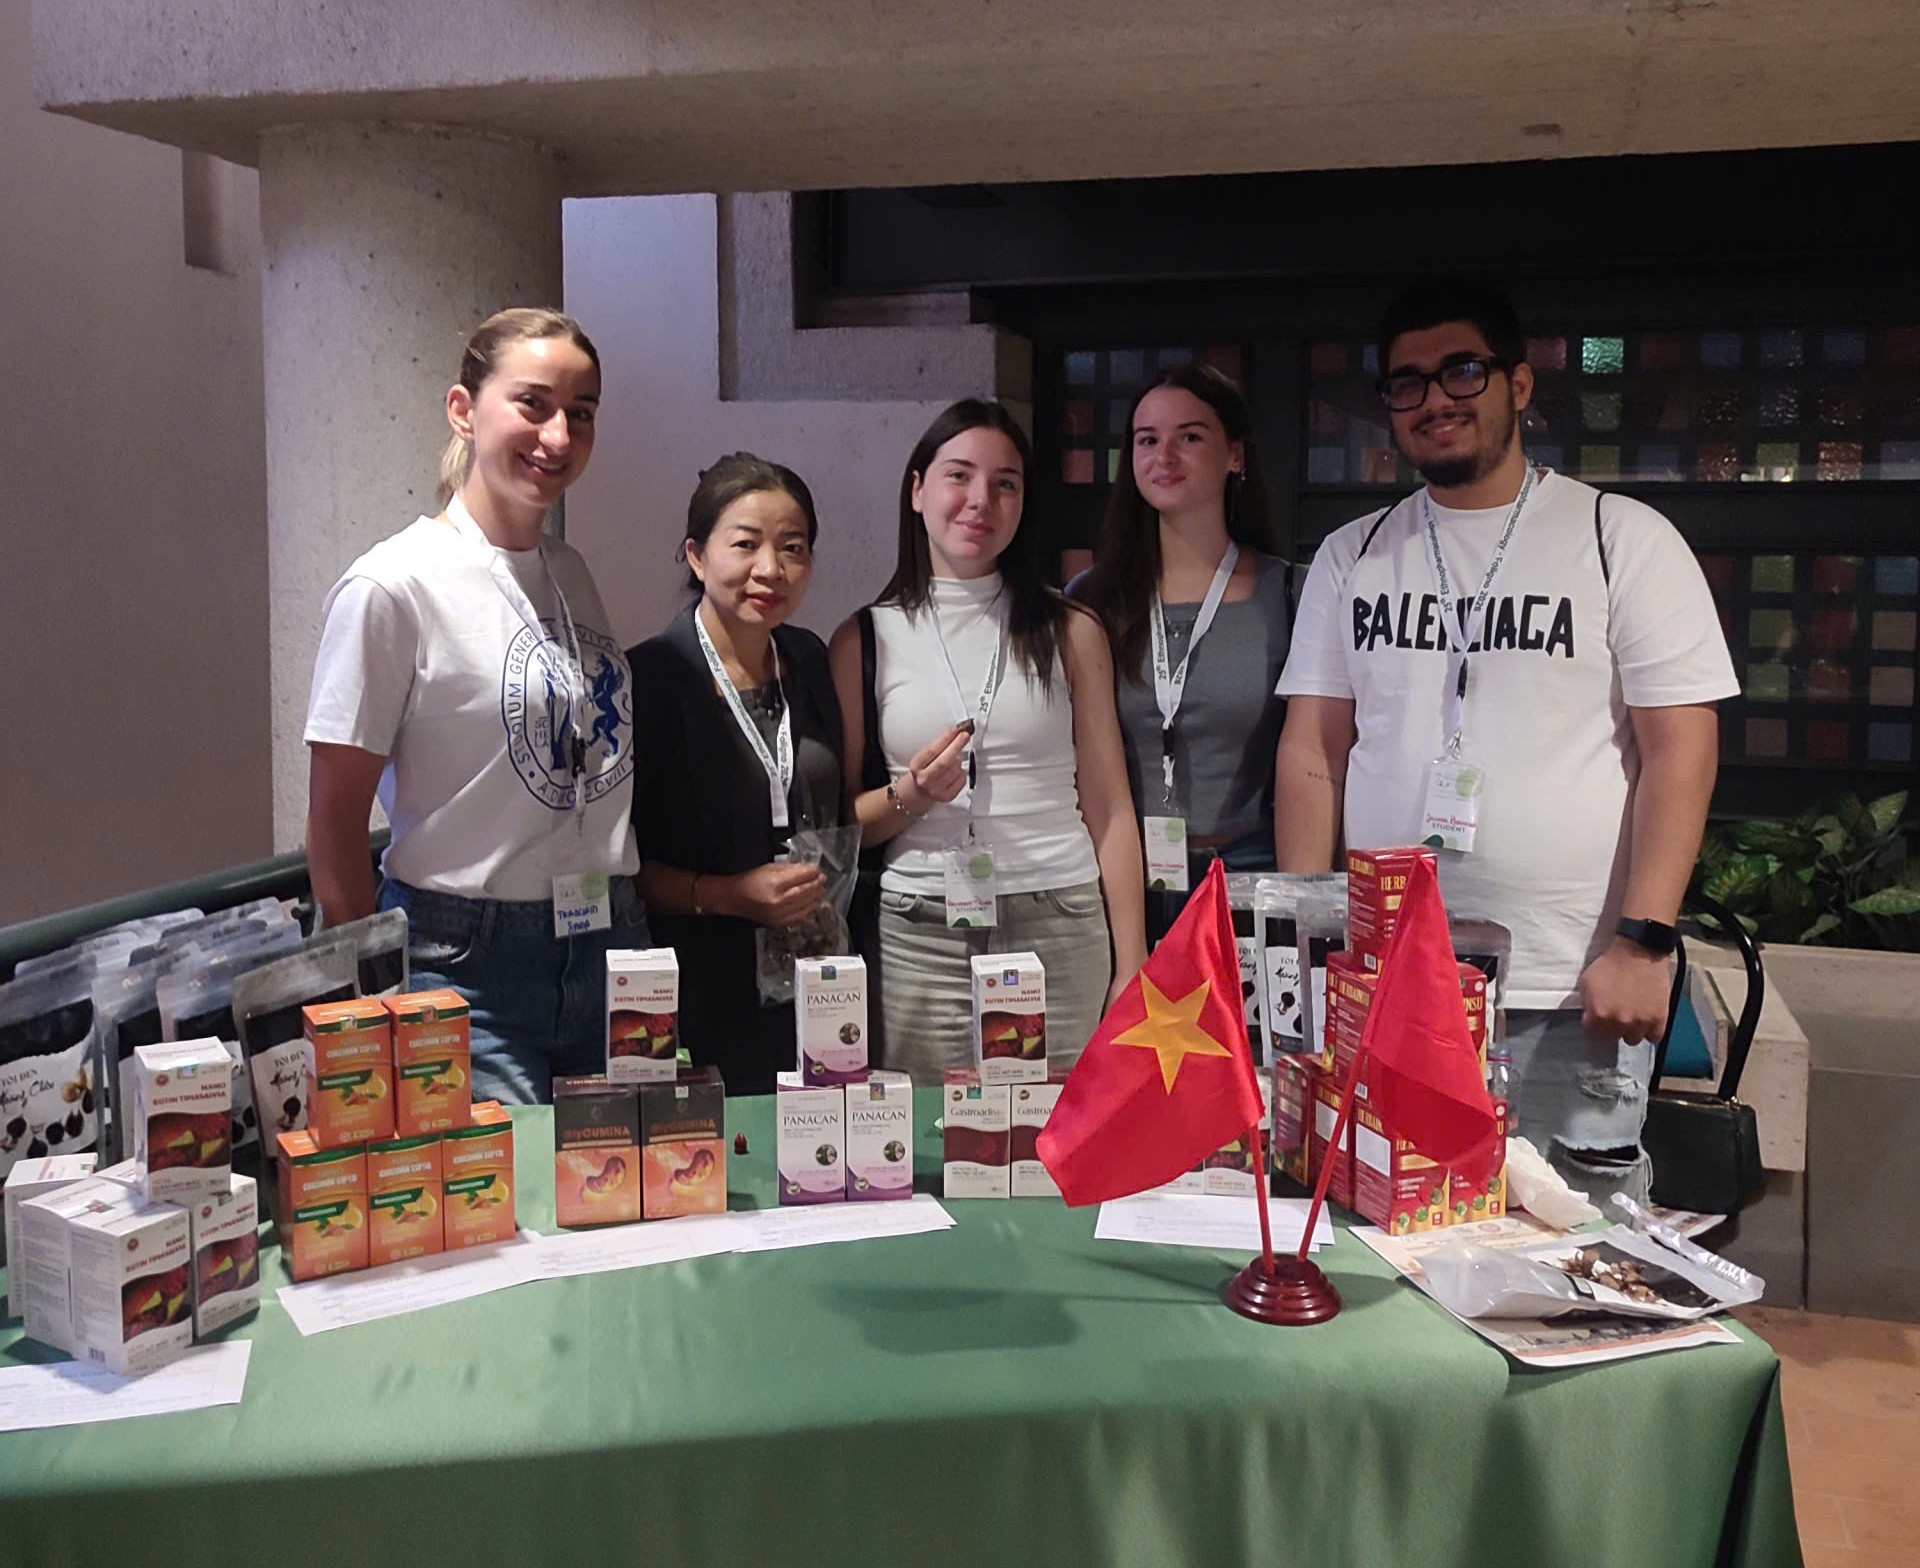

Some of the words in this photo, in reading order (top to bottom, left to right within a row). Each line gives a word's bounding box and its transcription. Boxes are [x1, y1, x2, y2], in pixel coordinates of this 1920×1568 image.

[1473, 589, 1489, 613] 2026
[1174, 665, 1185, 686] 026
[1431, 822, 1466, 833] STUDENT
[807, 992, 861, 1005] PANACAN
[783, 1113, 838, 1126] PANACAN
[852, 1110, 907, 1122] PANACAN
